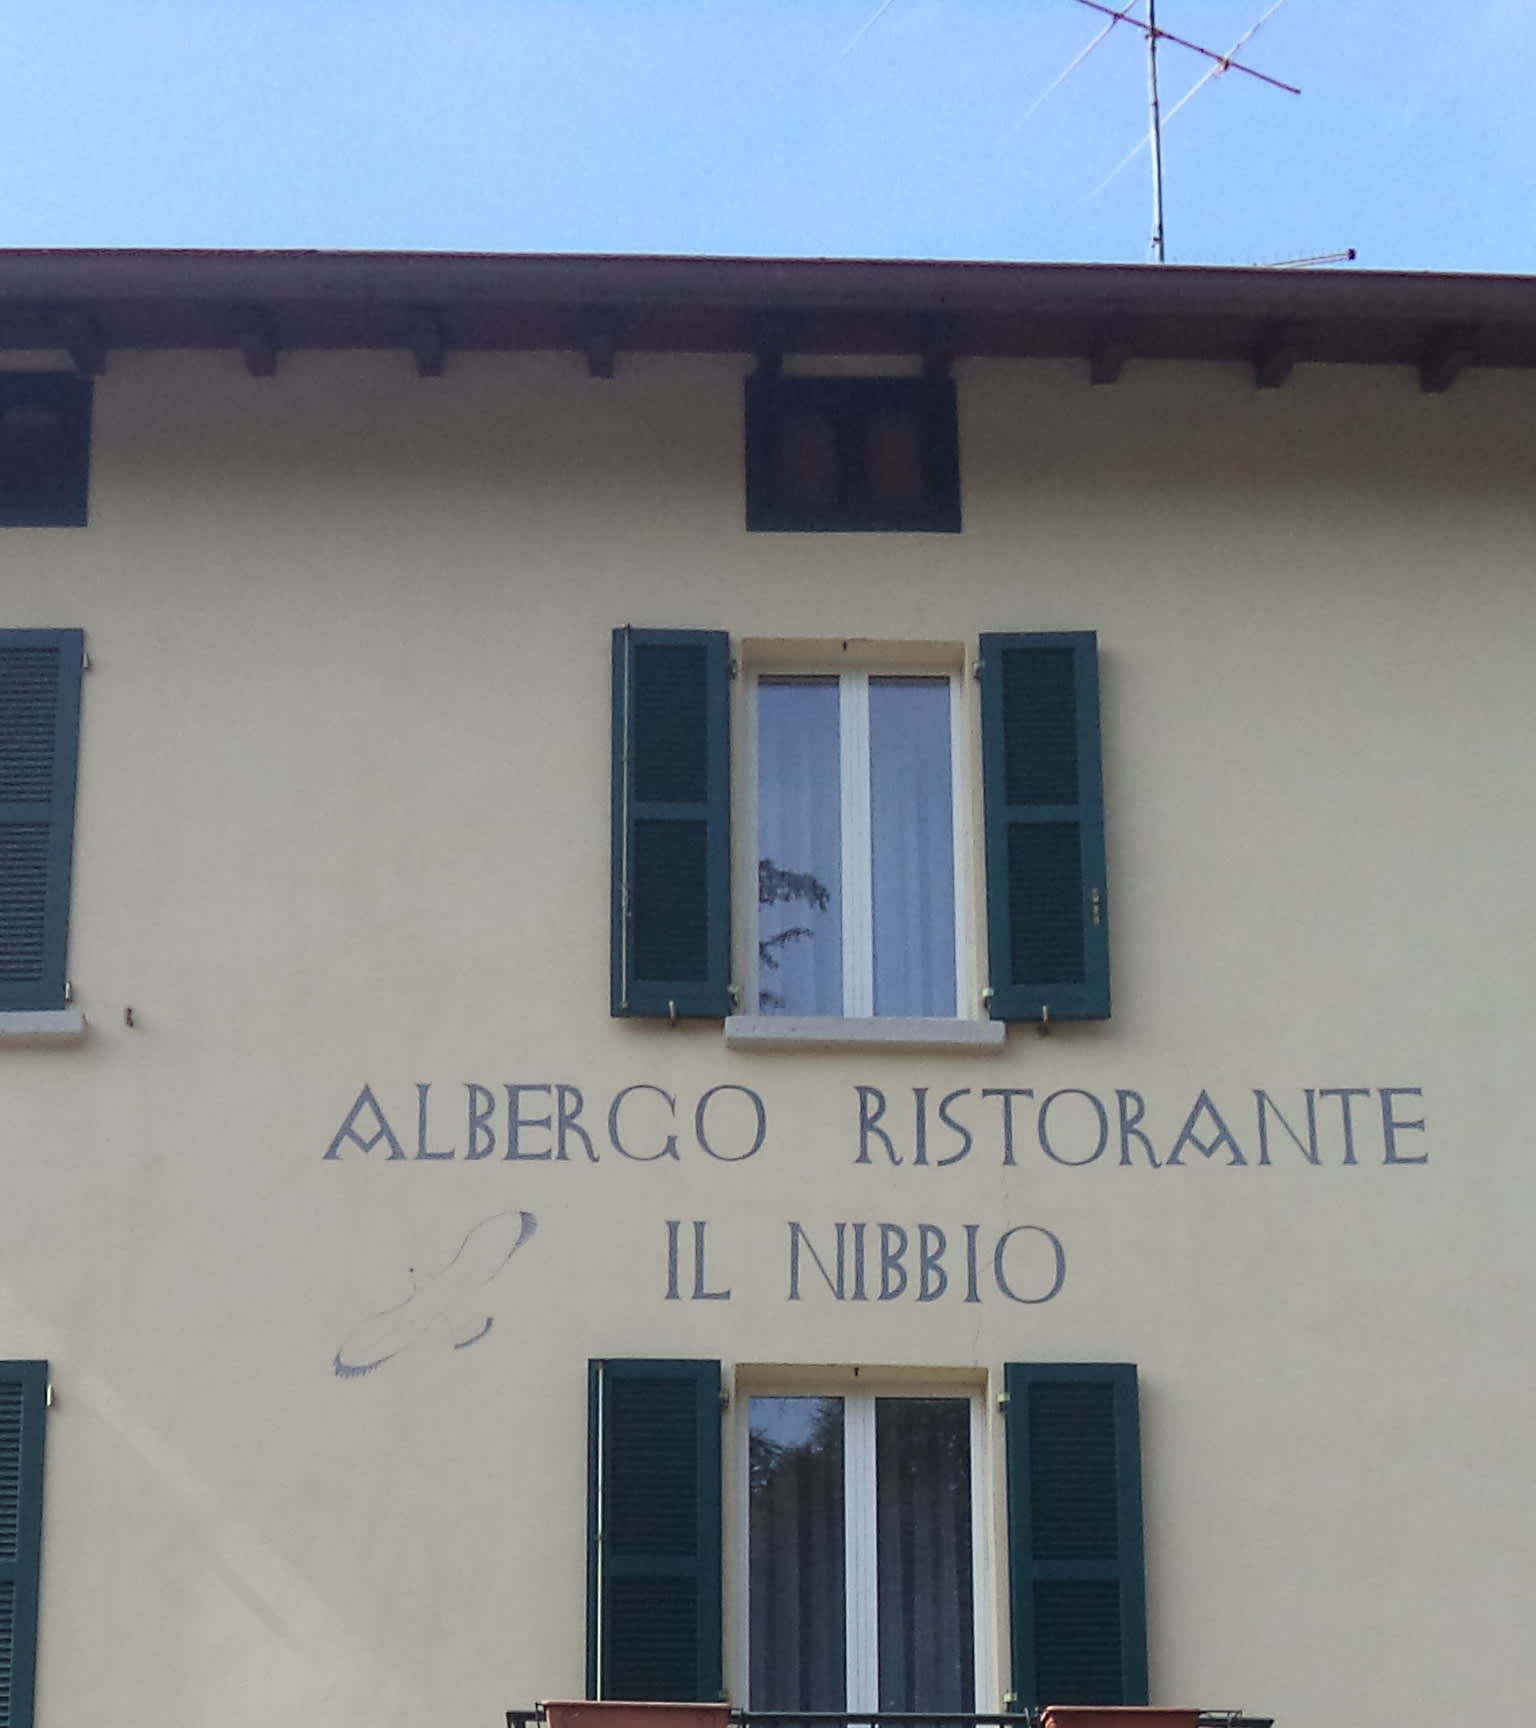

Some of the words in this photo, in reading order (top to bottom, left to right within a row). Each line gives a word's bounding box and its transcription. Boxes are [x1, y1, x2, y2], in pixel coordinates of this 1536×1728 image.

[321, 1082, 767, 1163] ALBERGO
[852, 1084, 1429, 1169] RISTORANTE
[664, 1220, 731, 1302] IL
[787, 1221, 1066, 1304] NIBBIO
